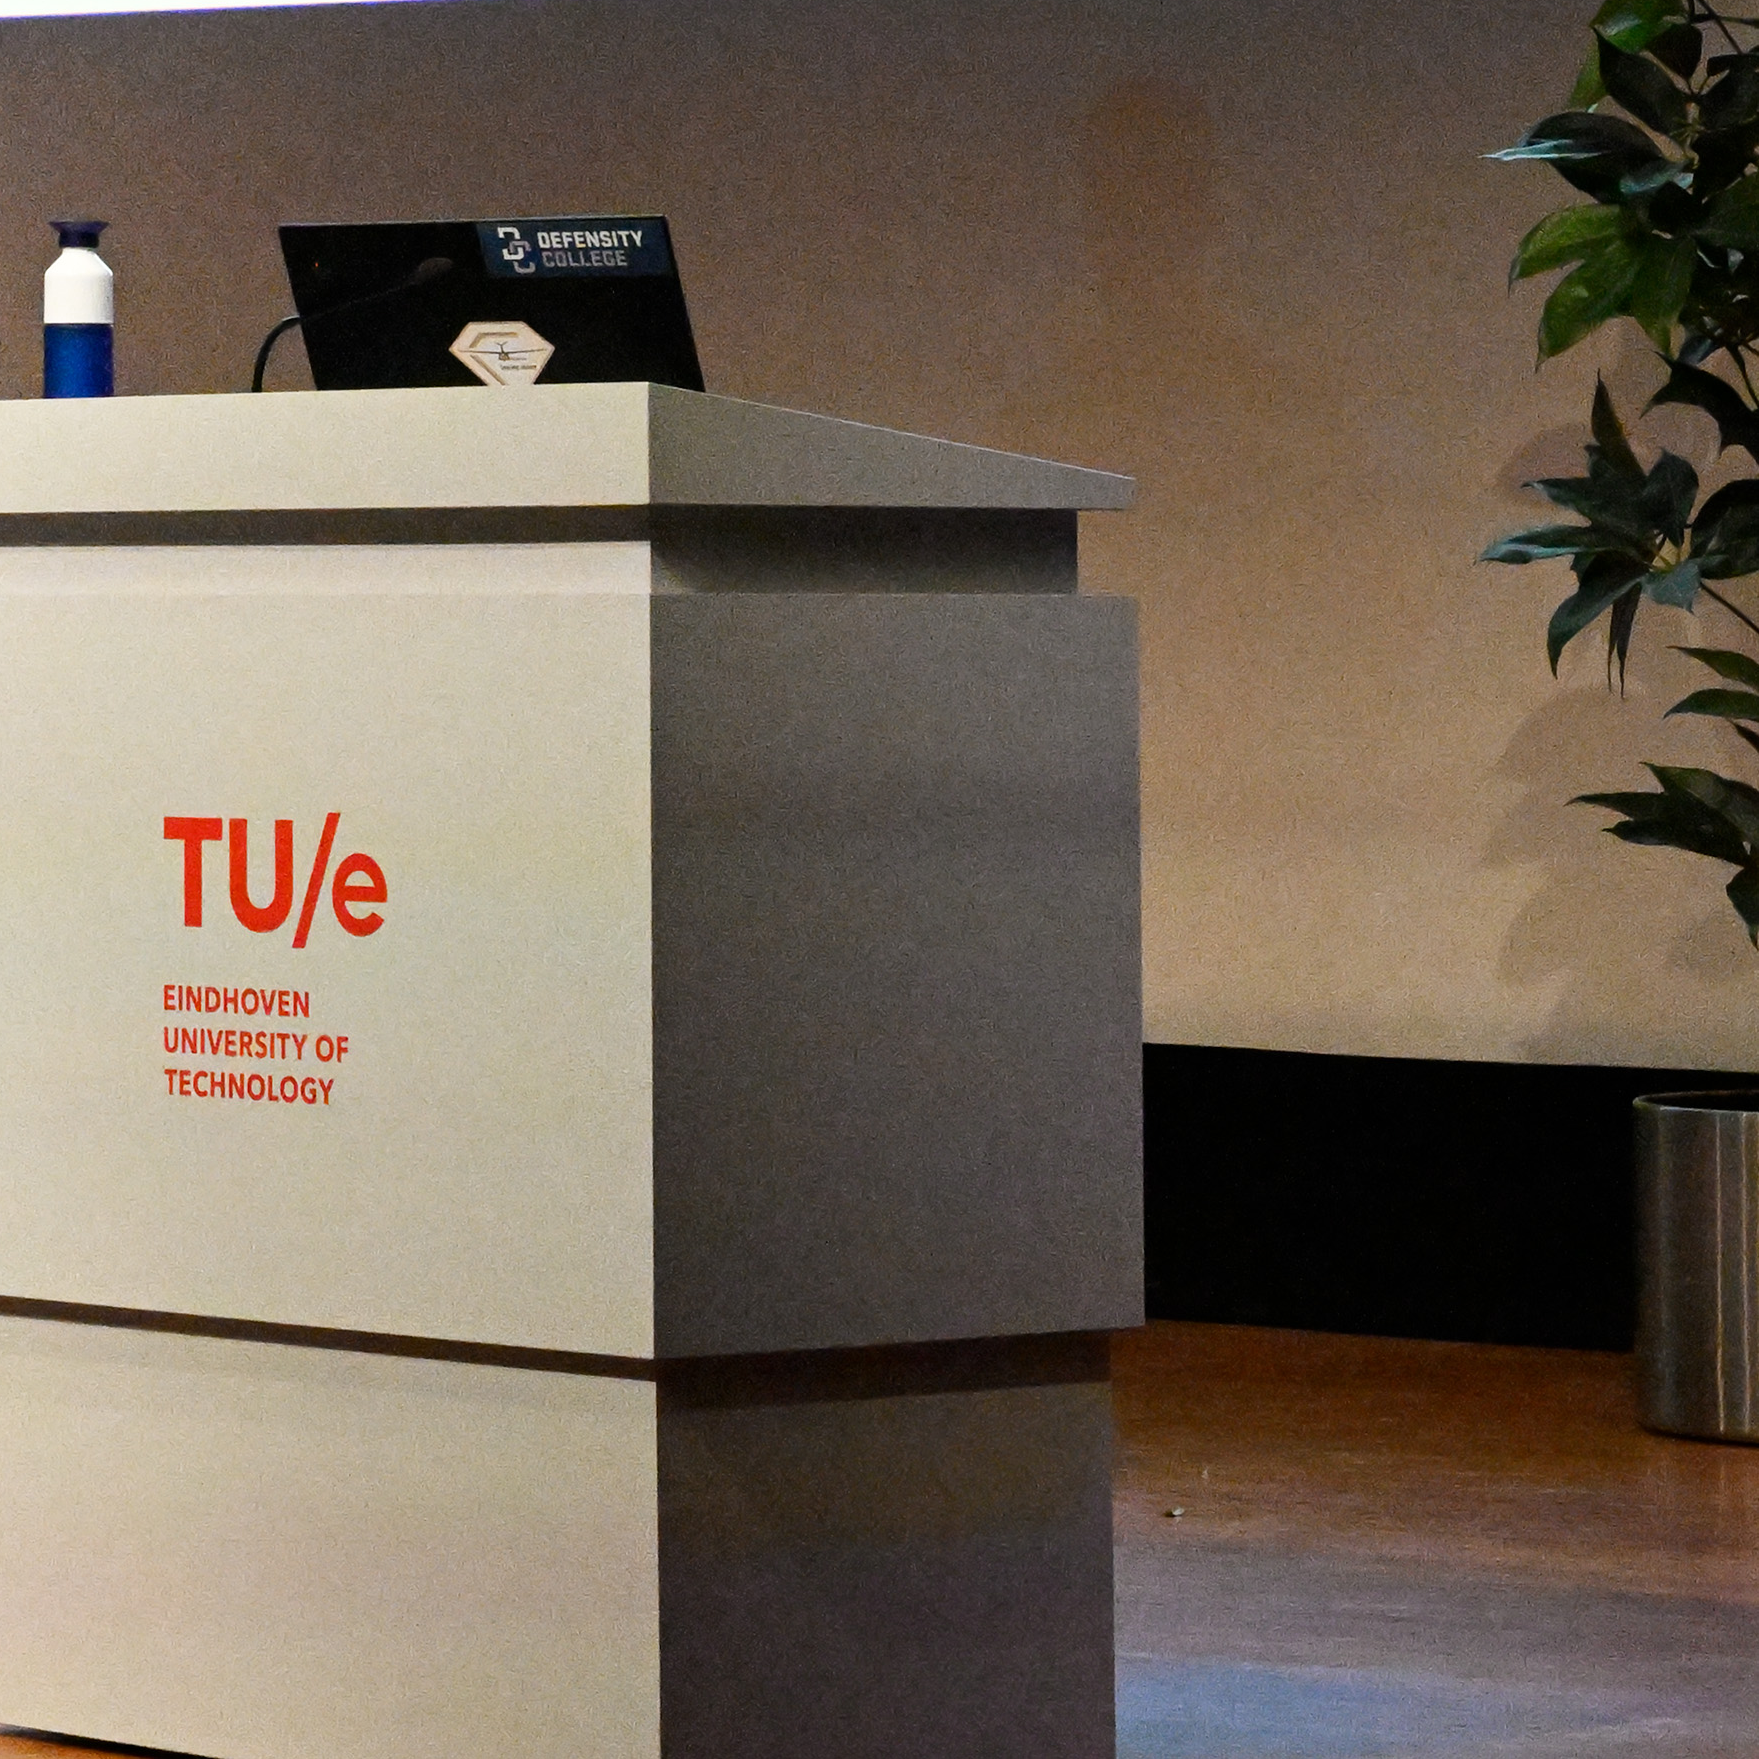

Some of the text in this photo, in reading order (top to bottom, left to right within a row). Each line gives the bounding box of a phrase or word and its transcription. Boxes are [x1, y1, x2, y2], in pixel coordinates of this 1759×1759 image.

[537, 230, 642, 249] DEFENSITY
[542, 250, 628, 267] COLLEGE
[163, 812, 388, 949] TU/e
[163, 984, 310, 1018] EINDHOVEN
[163, 1026, 349, 1063] UNIVERSITY OF
[164, 1068, 334, 1105] TECHNOLOGY
